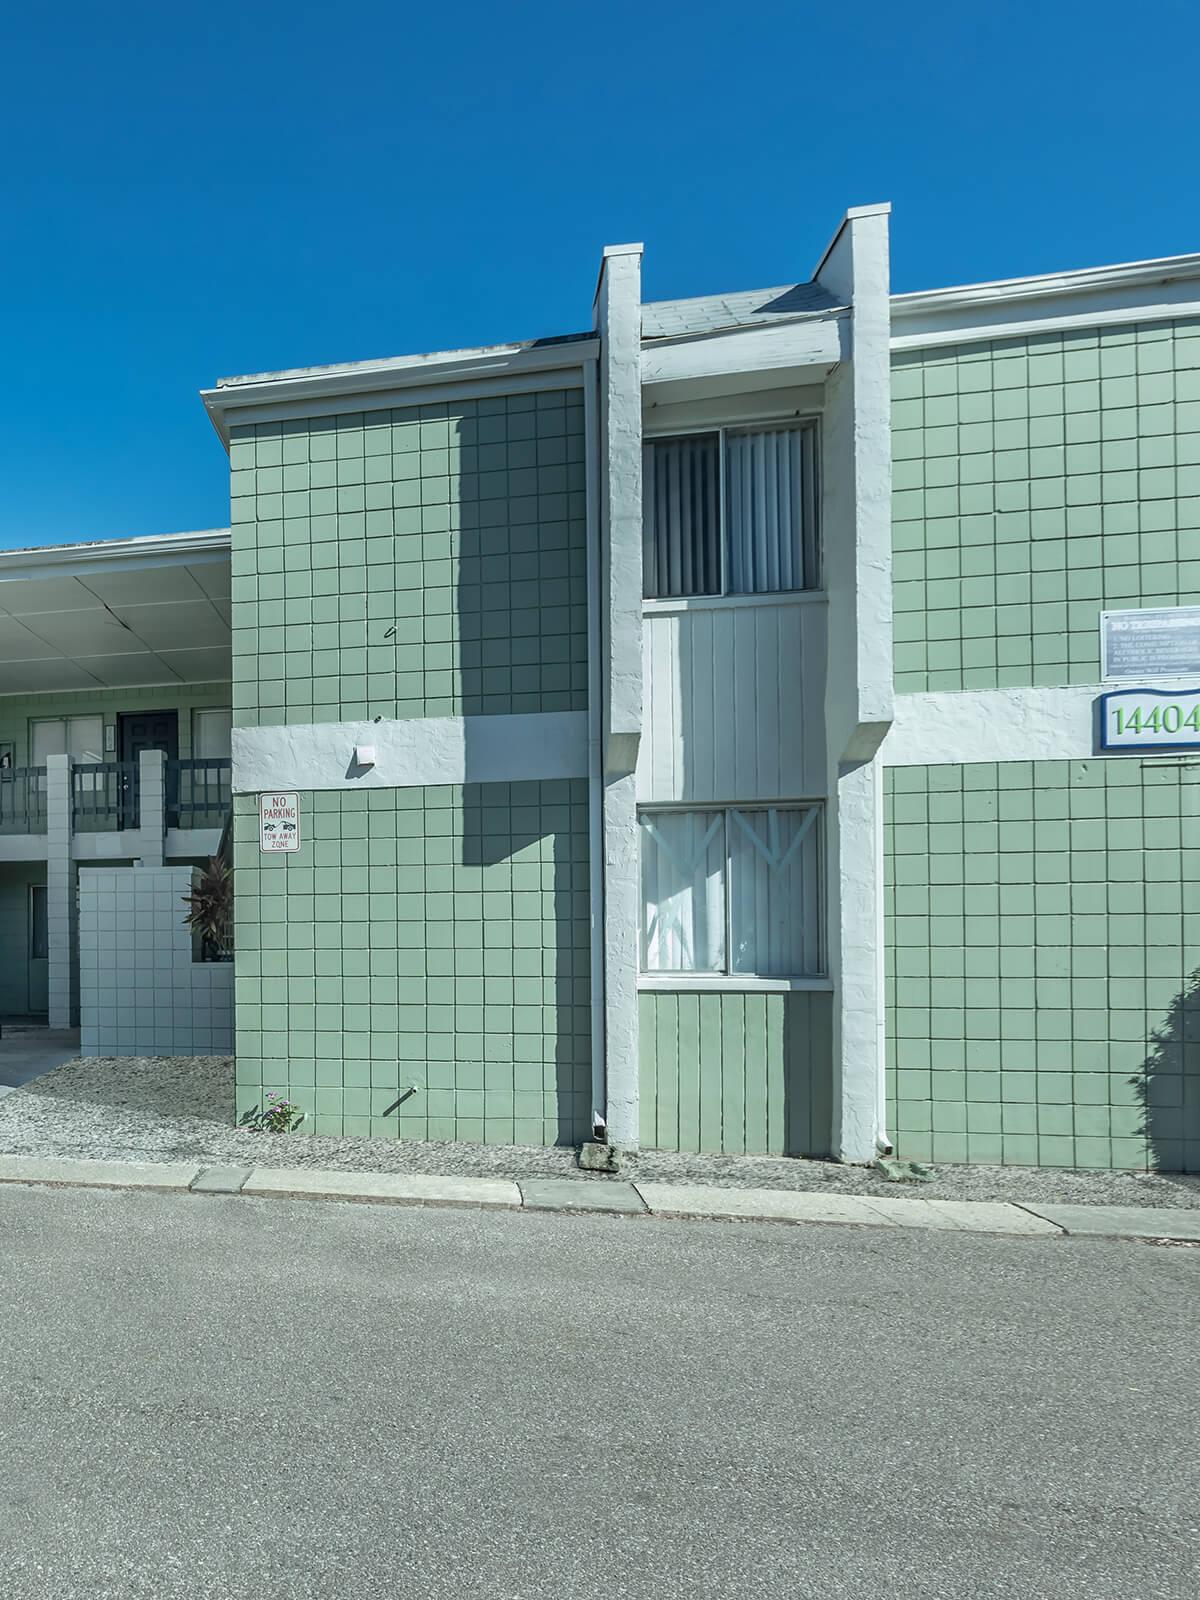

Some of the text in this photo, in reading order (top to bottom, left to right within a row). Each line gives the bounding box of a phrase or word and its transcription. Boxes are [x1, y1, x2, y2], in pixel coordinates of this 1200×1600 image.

[1112, 703, 1200, 735] 14404
[272, 797, 286, 807] NO
[264, 808, 295, 819] PARKING
[279, 832, 296, 840] AWAY
